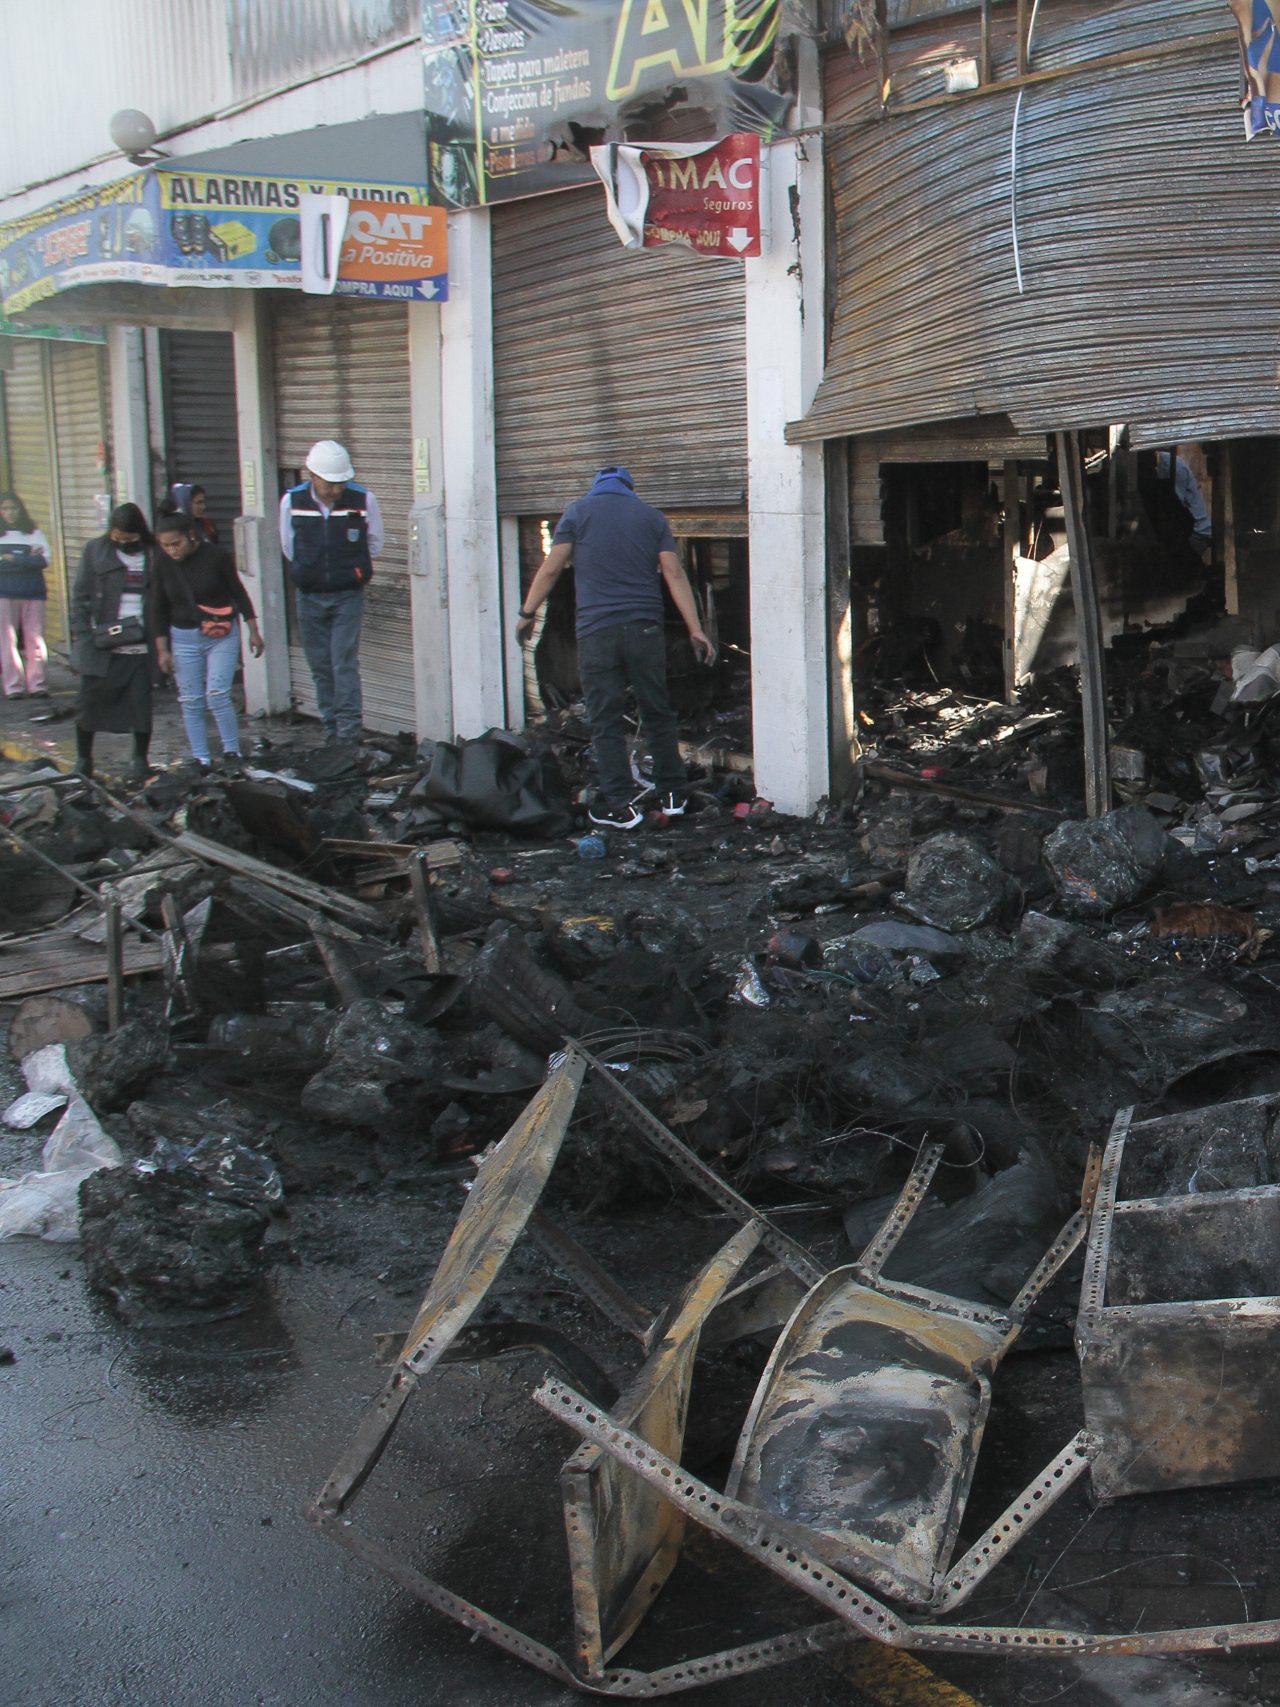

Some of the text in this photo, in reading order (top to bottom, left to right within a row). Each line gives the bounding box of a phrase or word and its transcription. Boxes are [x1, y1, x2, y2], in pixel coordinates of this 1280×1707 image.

[485, 48, 591, 87] Tapete para maletera
[486, 76, 593, 118] Confección de fundas
[653, 157, 753, 190] IMAC
[170, 177, 301, 209] ALARMAS
[704, 197, 753, 214] Seguros
[344, 210, 433, 245] OAT
[359, 246, 434, 269] Positiva
[336, 280, 414, 298] OMPRA AQUI
